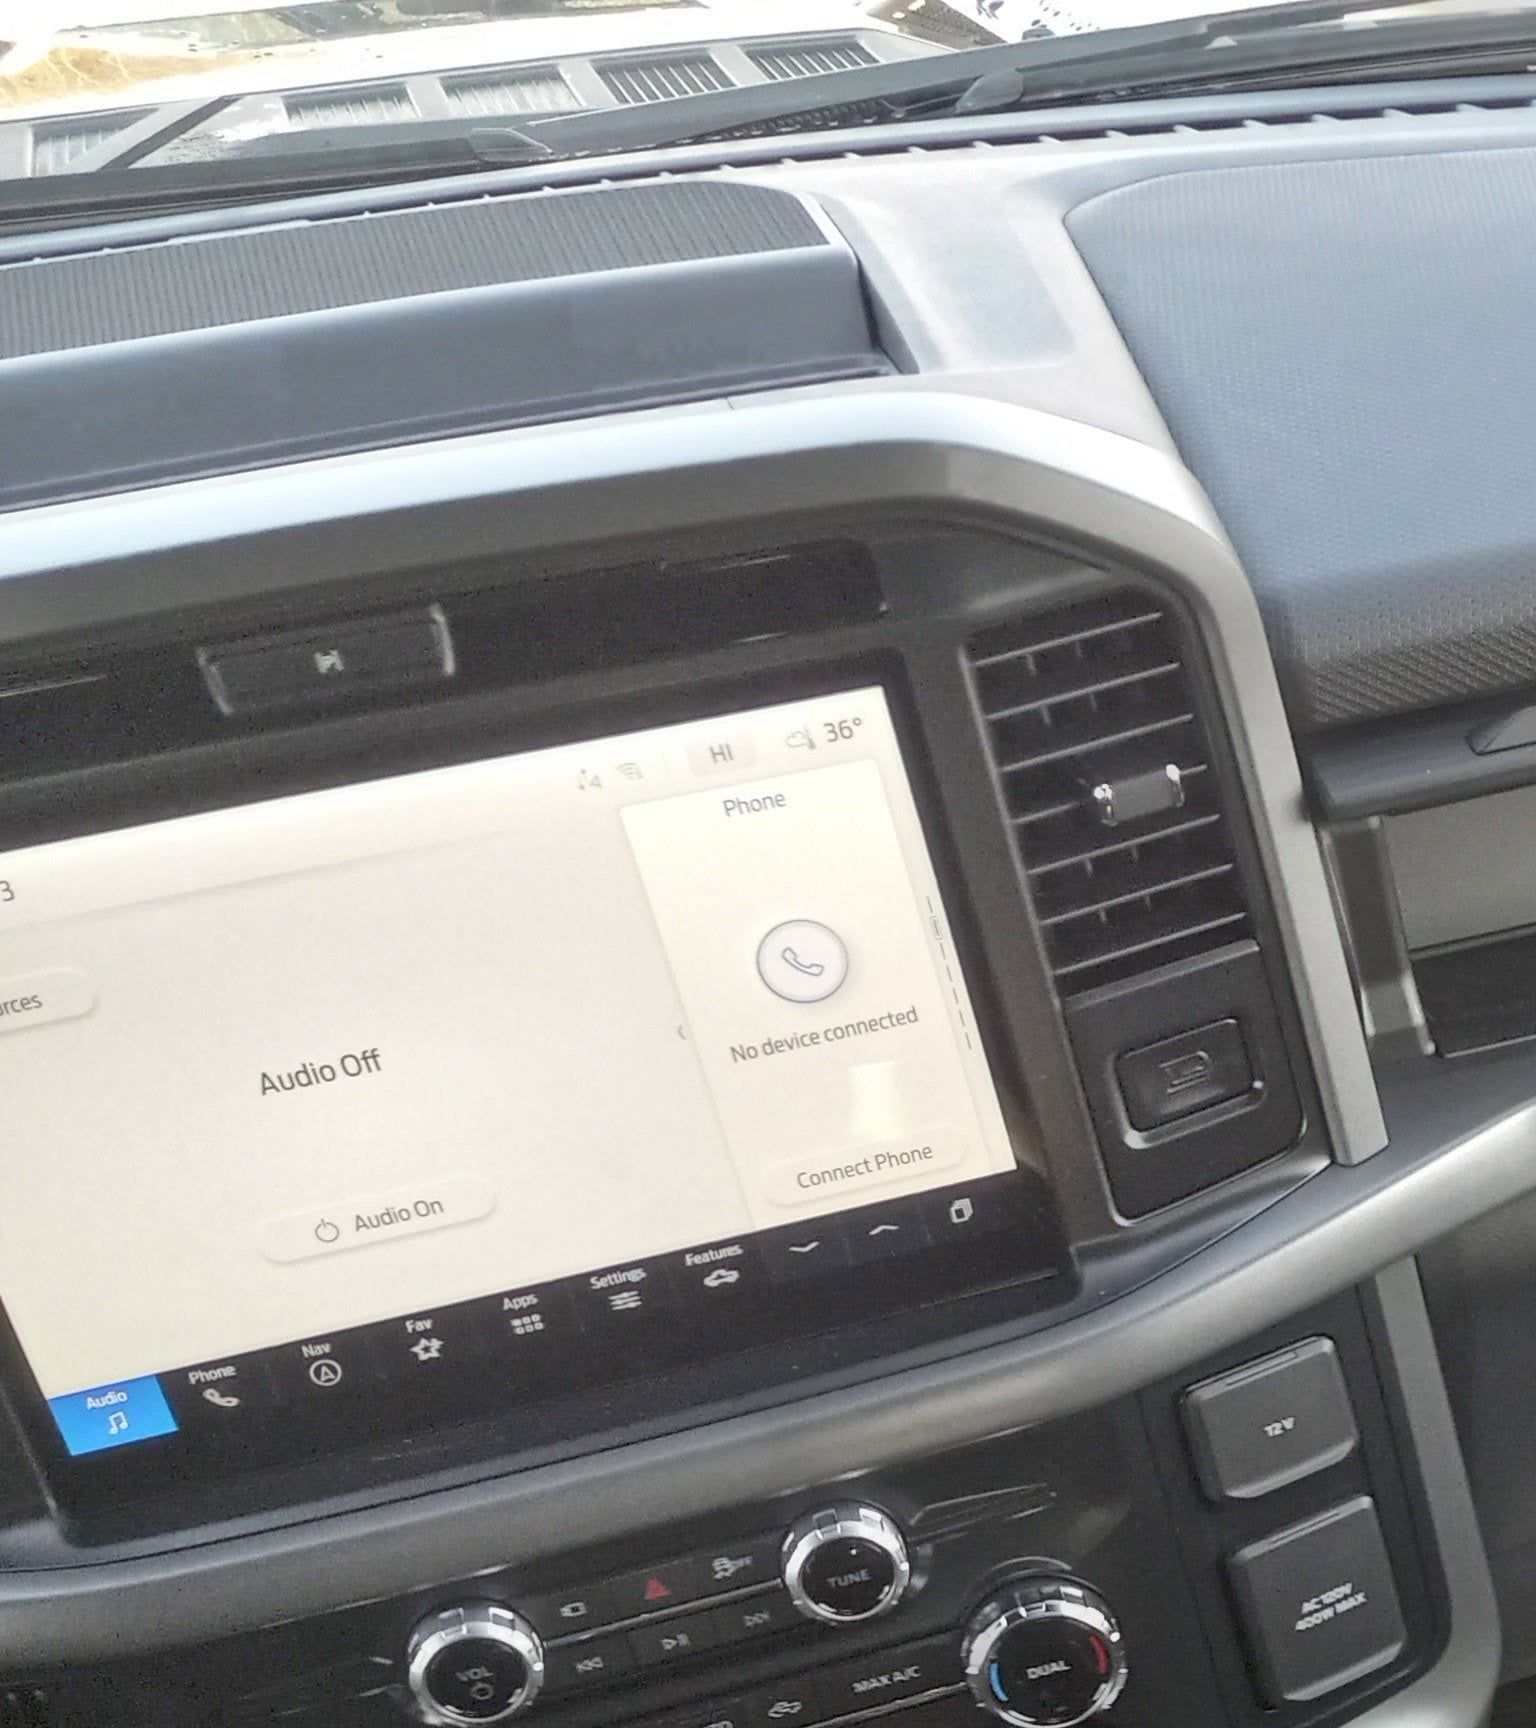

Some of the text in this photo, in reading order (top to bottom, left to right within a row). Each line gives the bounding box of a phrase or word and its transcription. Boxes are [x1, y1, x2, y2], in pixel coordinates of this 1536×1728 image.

[823, 717, 862, 743] 36°
[708, 742, 734, 764] HI
[722, 793, 786, 818] Phone
[730, 1006, 919, 1063] No device connected
[261, 1048, 382, 1096] Audio Off
[797, 1145, 934, 1189] Connect Phone
[355, 1200, 444, 1233] Audio On
[685, 1245, 743, 1267] Features
[590, 1267, 647, 1290] Settings
[502, 1293, 539, 1312] Apps
[405, 1318, 433, 1334] Fav
[301, 1341, 332, 1359] Nav
[187, 1364, 237, 1386] Phone
[86, 1390, 129, 1411] Audio
[826, 1568, 871, 1589] TUNE
[1025, 1660, 1072, 1680] DUAL
